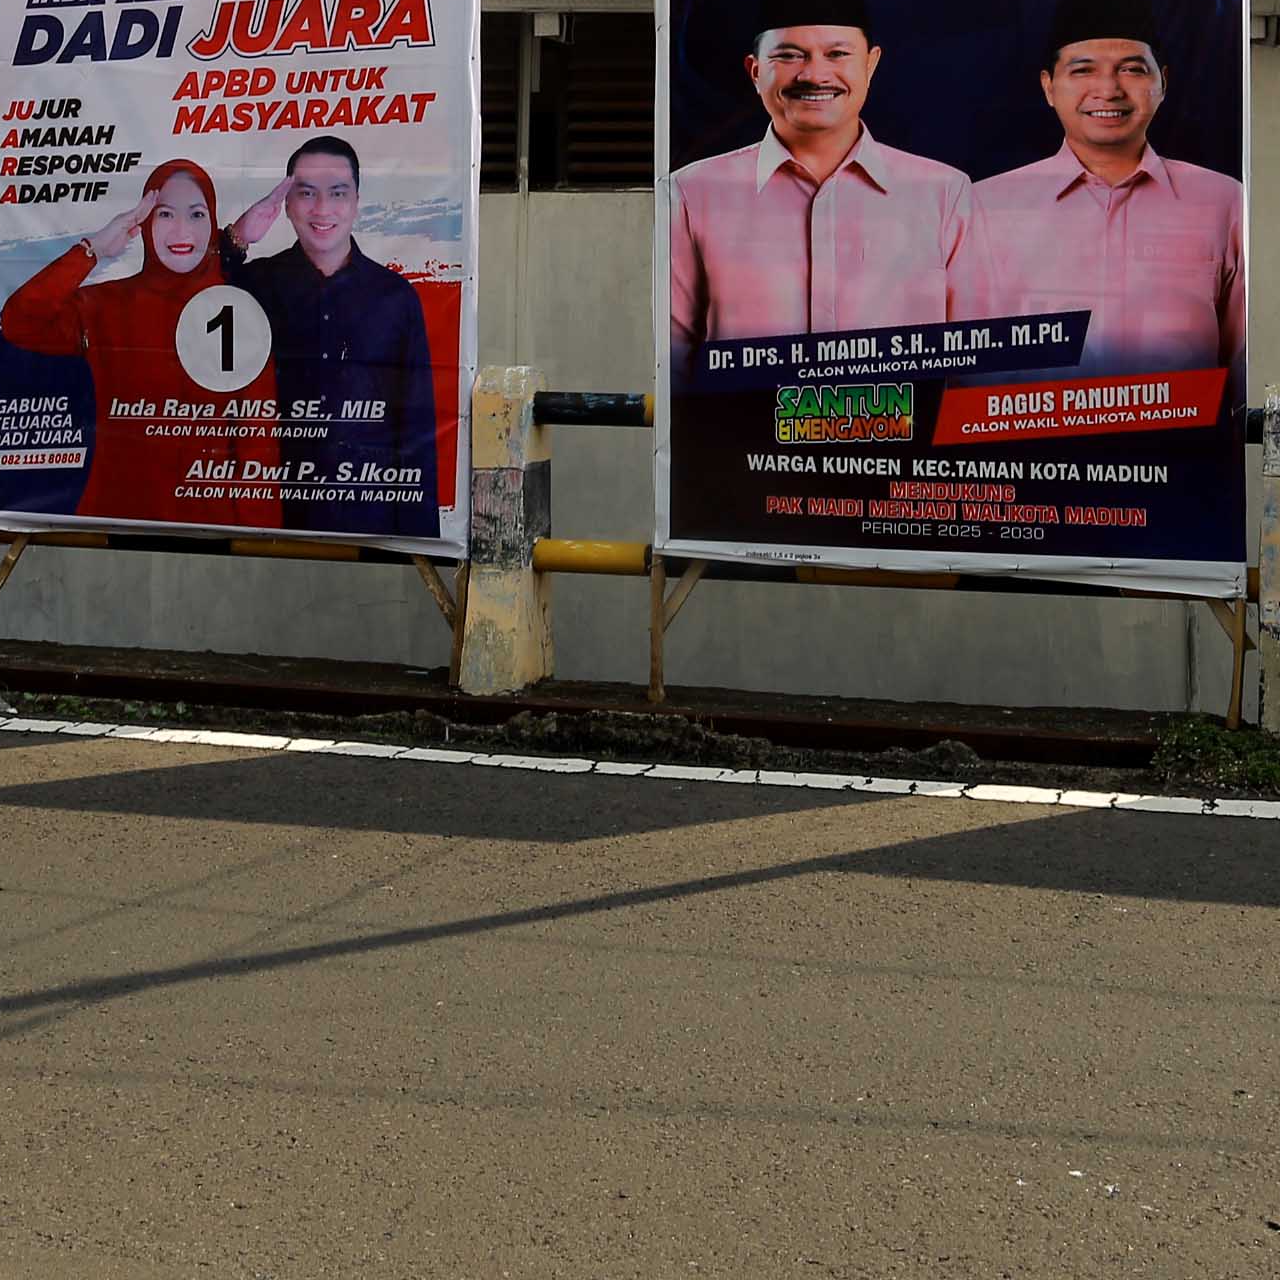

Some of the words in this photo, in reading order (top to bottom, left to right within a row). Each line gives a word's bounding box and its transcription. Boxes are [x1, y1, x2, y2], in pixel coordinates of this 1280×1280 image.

[12, 6, 184, 66] DADI
[173, 68, 276, 101] APBD
[285, 67, 388, 93] UNTUK
[2, 99, 82, 122] JUJUR
[172, 93, 436, 135] MASYARAKAT
[0, 126, 115, 149] AMANAH
[0, 152, 142, 177] RESPONSIF
[0, 181, 109, 205] ADAPTIF
[206, 305, 235, 372] 1
[708, 349, 735, 370] Dr.
[742, 347, 784, 368] Drs.
[791, 343, 810, 363] H.
[817, 337, 883, 362] MAIDI,
[891, 334, 936, 357] S.H.,
[943, 328, 1004, 353] M.M.,
[1011, 322, 1070, 347] M.Pd.
[798, 367, 844, 379] CALON
[848, 360, 918, 376] WALIKOTA
[922, 356, 977, 370] MADIUN
[110, 398, 156, 417] Inda
[163, 399, 216, 421] Raya
[221, 399, 282, 420] AMS,
[290, 400, 333, 421] SE.,
[341, 400, 386, 419] MIB
[776, 383, 912, 417] SANTUN
[987, 391, 1055, 417] BAGUS
[1063, 382, 1170, 411] PANUNTUN
[145, 425, 192, 437] CALON
[195, 426, 266, 437] WALIKOTA
[270, 427, 328, 438] MADIUN
[962, 421, 1009, 434] CALON
[1013, 417, 1059, 431] WAKIL
[1062, 411, 1136, 427] WALIKOTA
[1140, 406, 1198, 420] MADIUN
[31, 429, 83, 445] JUARA
[1, 454, 20, 465] 082
[22, 453, 45, 464] 1113
[48, 452, 81, 464] 80808
[747, 454, 817, 473] WARGA
[823, 457, 901, 476] KUNCEN
[913, 459, 1024, 480] KEC.TAMAN
[1030, 462, 1081, 481] KOTA
[1086, 464, 1168, 484] MADIUN
[186, 460, 237, 479] Aldi
[242, 461, 290, 480] Dwi
[297, 462, 327, 484] P.,
[174, 486, 225, 498] CALON
[231, 488, 274, 499] WAKIL
[279, 488, 355, 501] WALIKOTA
[360, 490, 424, 503] MADIUN
[890, 481, 1016, 503] MENDUKUNG
[766, 496, 803, 515] PAK
[808, 498, 863, 517] MAIDI
[869, 499, 956, 521] MENJADI
[962, 503, 1059, 524] WALIKOTA
[1065, 506, 1147, 527] MADIUN
[862, 521, 932, 536] PERIODE
[938, 524, 981, 538] 2025
[1000, 526, 1045, 540] 2030
